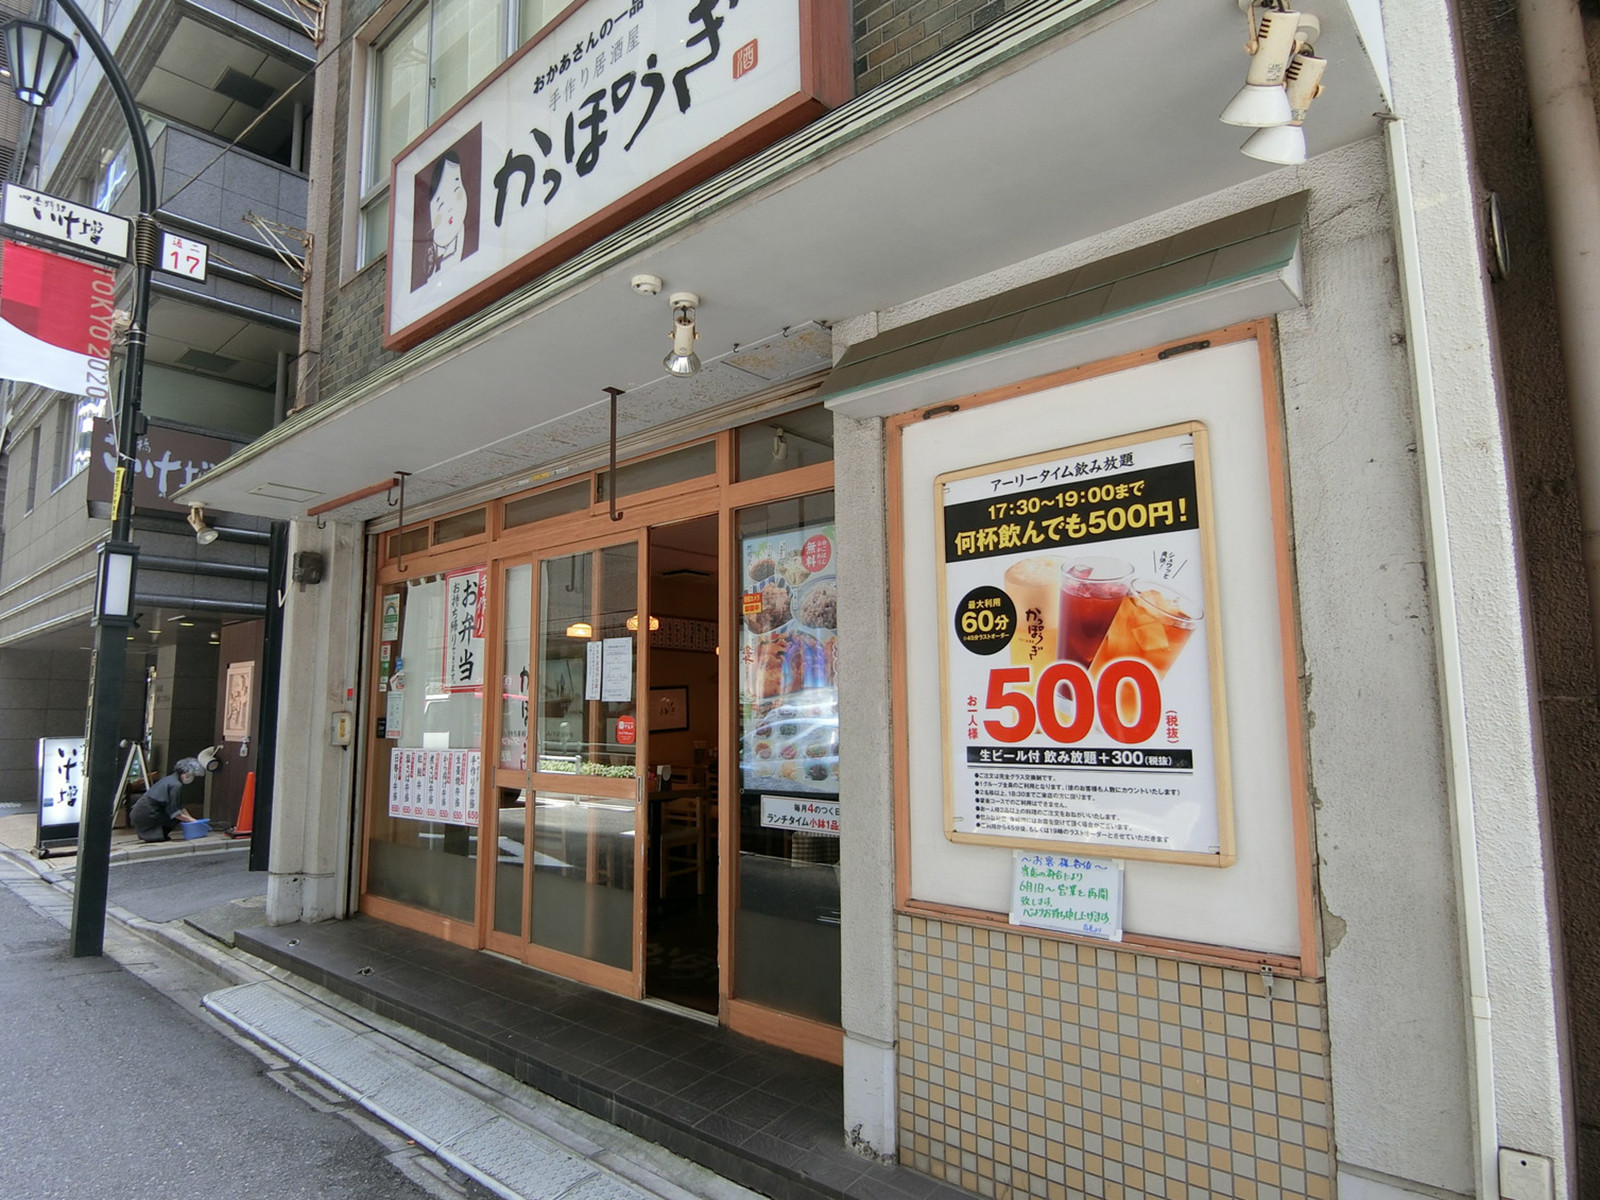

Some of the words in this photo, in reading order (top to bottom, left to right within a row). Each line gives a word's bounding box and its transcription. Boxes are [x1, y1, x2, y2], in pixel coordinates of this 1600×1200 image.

[548, 24, 640, 112] 手作り居酒屋
[736, 43, 754, 78] 酒
[170, 251, 199, 274] 17
[88, 268, 115, 341] TOKYO
[85, 343, 110, 399] 2020
[991, 452, 1135, 492] アーリータイム飲み放題
[954, 498, 1189, 555] 何杯飲んでも500円!
[458, 579, 478, 681] お弁当
[962, 610, 1009, 633] 60分
[968, 598, 1001, 609] 最大利用
[1025, 607, 1044, 660] かっぽうぎ
[967, 695, 978, 739] お一人様
[983, 660, 1161, 744] 500
[57, 748, 78, 807] いけ増
[980, 749, 1041, 763] 生ビール付
